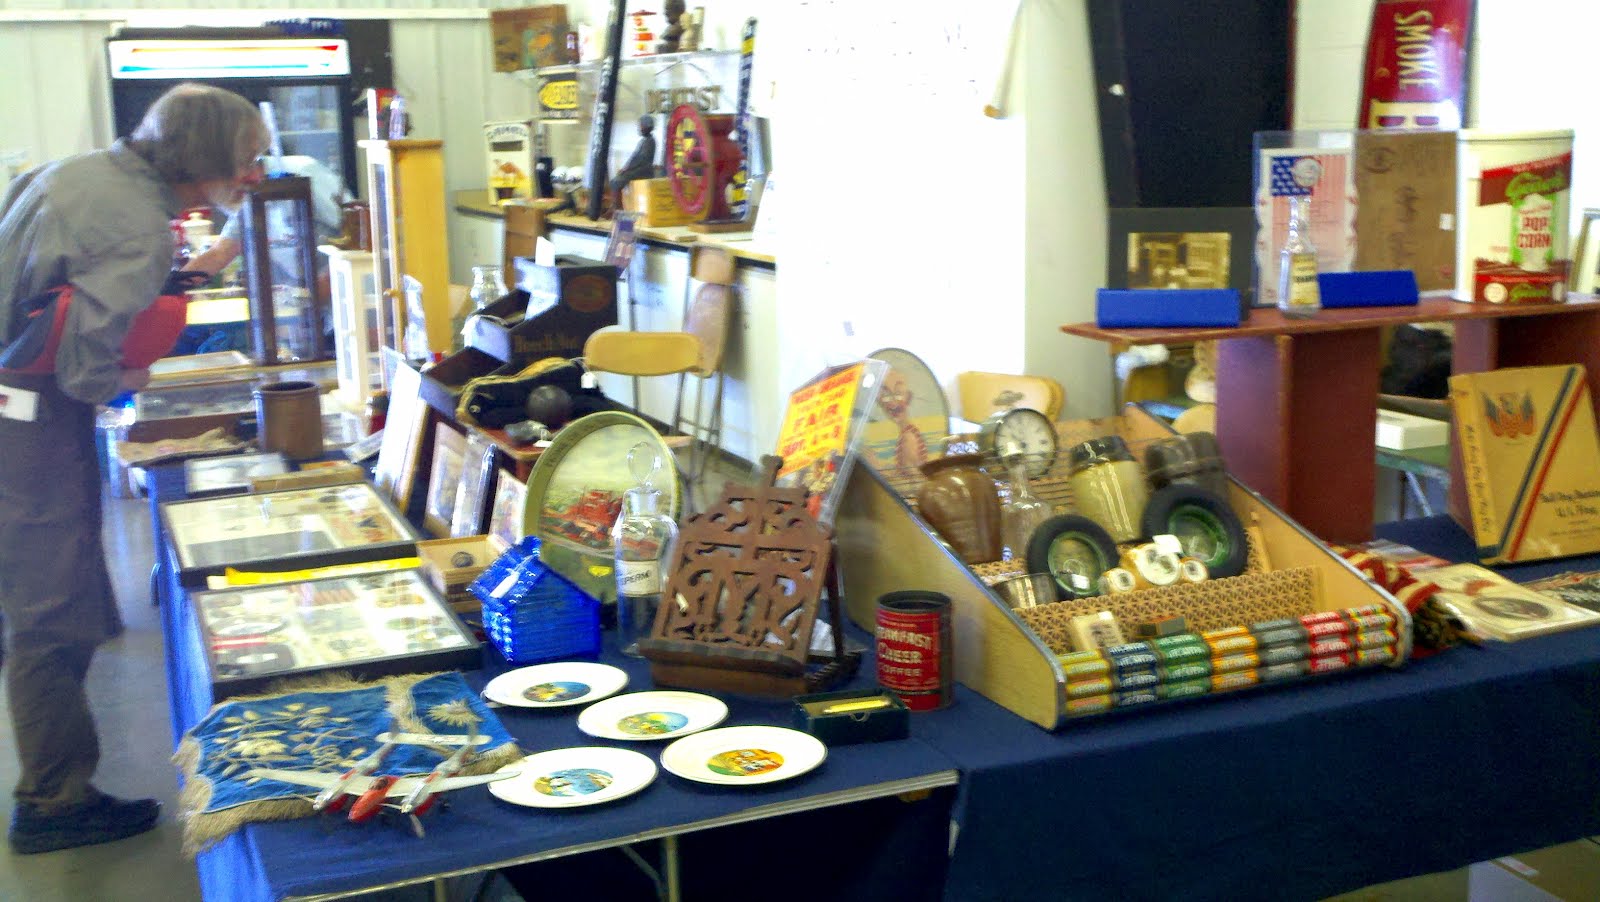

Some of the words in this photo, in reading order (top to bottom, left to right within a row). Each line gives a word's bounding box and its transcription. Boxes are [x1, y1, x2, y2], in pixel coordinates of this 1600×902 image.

[1394, 10, 1441, 91] SMOKE
[647, 85, 721, 113] DENTIST
[1522, 216, 1549, 231] POP
[1517, 233, 1552, 249] CORN
[793, 404, 840, 433] FAIR
